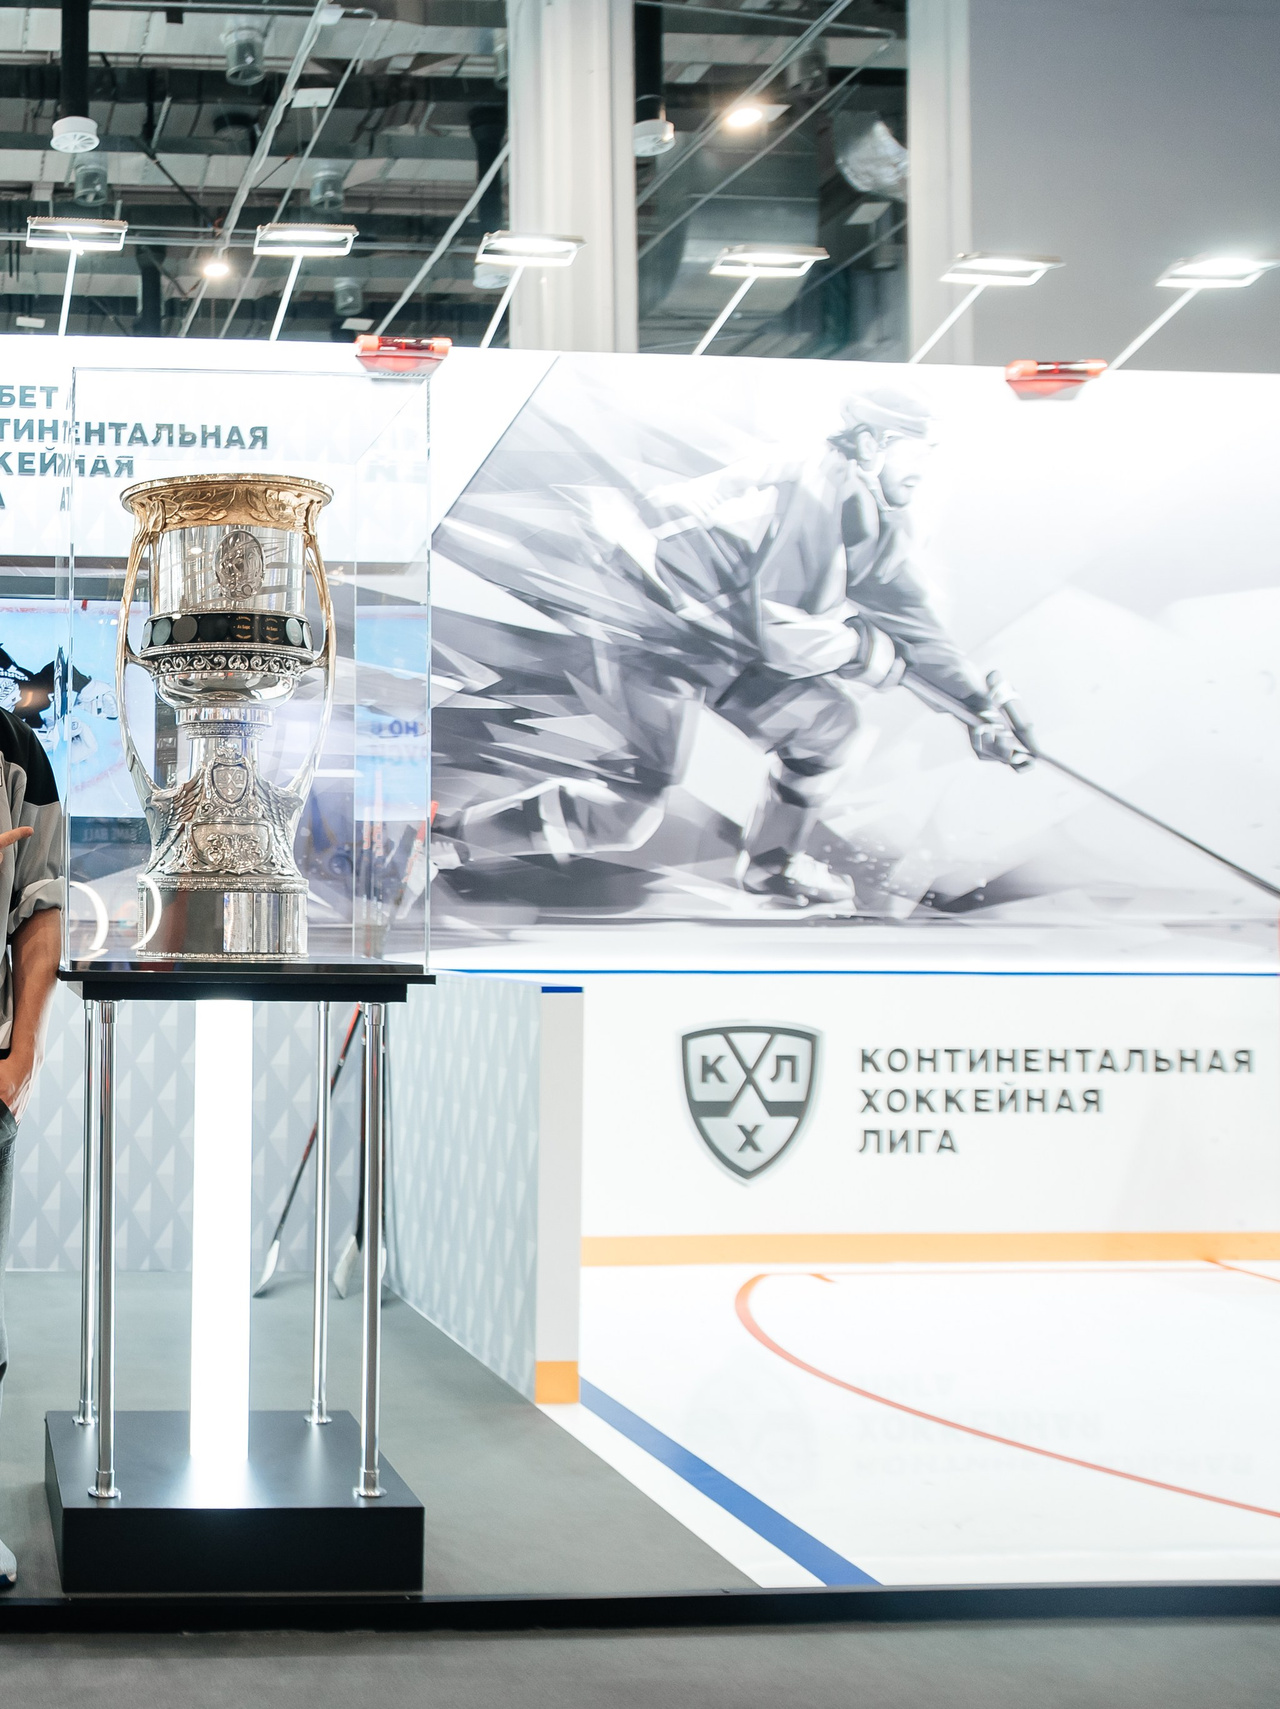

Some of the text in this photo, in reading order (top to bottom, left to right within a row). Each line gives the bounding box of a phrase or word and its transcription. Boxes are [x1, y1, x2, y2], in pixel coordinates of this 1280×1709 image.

[859, 1047, 1255, 1075] КОНТИНЕНТАЛЬНАЯ
[859, 1081, 1103, 1114] ХОККЕЙНАЯ
[858, 1128, 959, 1155] ЛИГА
